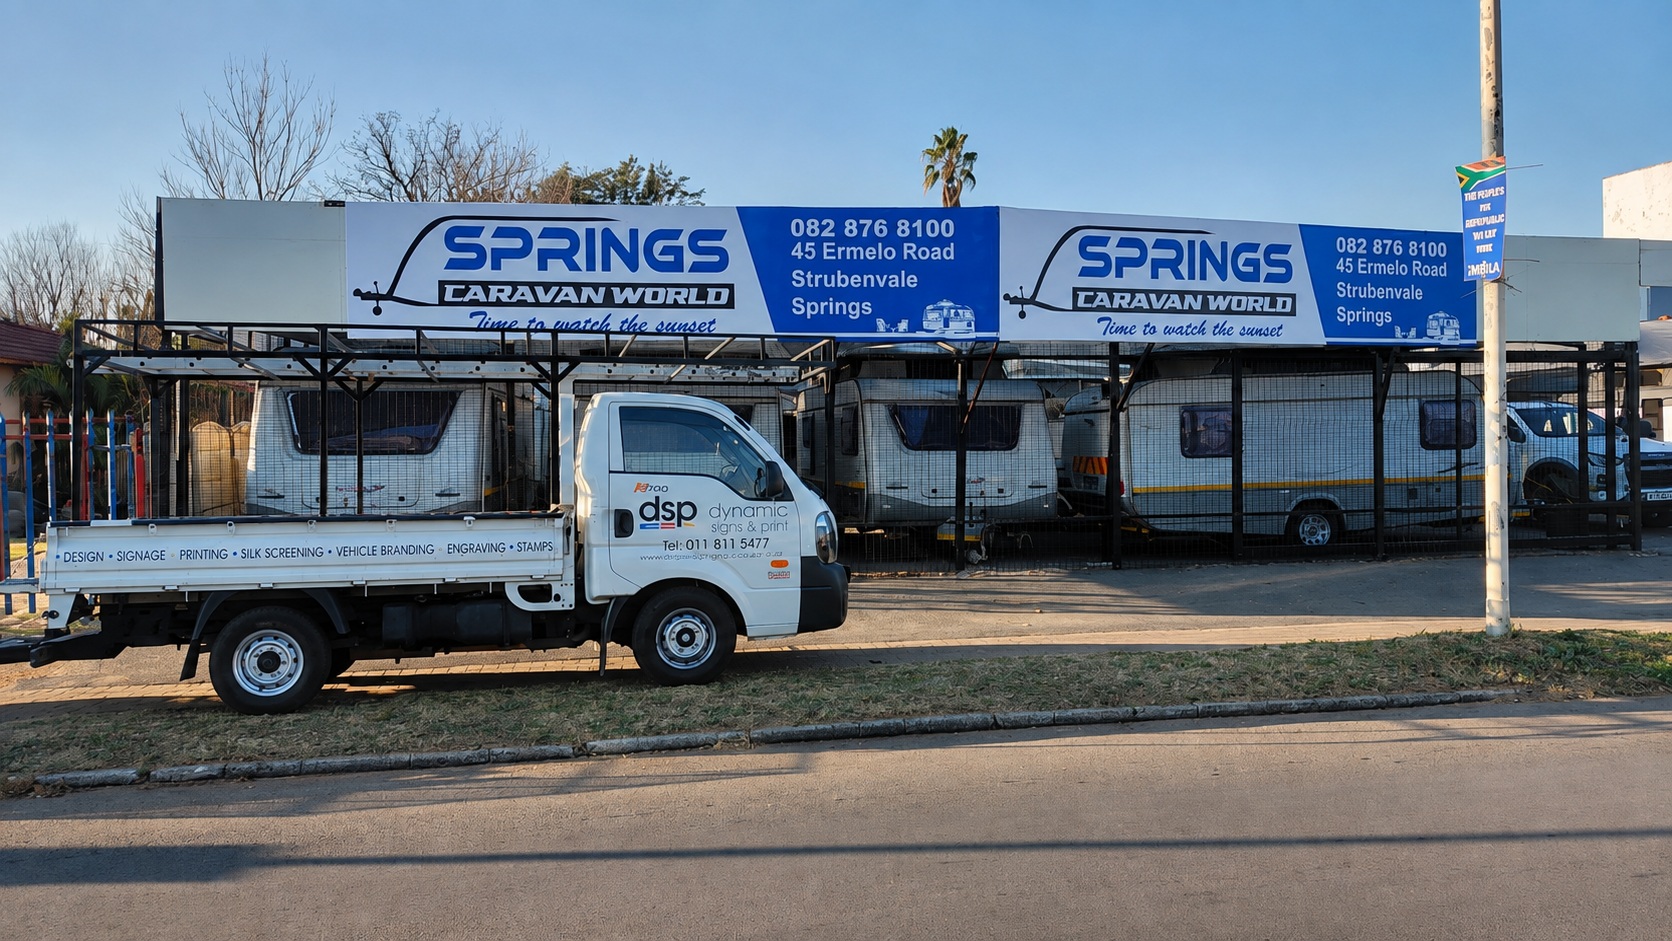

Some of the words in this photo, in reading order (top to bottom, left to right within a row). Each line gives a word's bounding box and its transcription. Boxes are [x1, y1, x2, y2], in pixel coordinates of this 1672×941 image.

[790, 218, 836, 238] 082
[844, 219, 888, 238] 876
[896, 219, 955, 238] 8100
[444, 225, 729, 273] SPRINGS
[791, 242, 816, 260] 45
[823, 242, 896, 260] Ermelo
[903, 242, 955, 260] Road
[1336, 236, 1367, 254] 082
[1373, 238, 1403, 256] 876
[1409, 241, 1447, 257] 8100
[1078, 235, 1293, 283] SPRINGS
[1336, 257, 1353, 274] 45
[1358, 258, 1408, 276] Ermelo
[1412, 260, 1447, 277] Road
[791, 269, 918, 288] Strubenvale
[444, 284, 606, 304] CARAVAN
[611, 287, 730, 305] WORLD
[1336, 281, 1423, 300] Strubenvale
[791, 296, 872, 319] Springs
[1076, 291, 1202, 311] CARAVAN
[1207, 295, 1292, 313] WORLD
[469, 310, 519, 331] Time
[528, 317, 544, 332] to
[554, 312, 612, 332] watch
[619, 313, 648, 333] the
[655, 318, 717, 333] sunset
[1097, 316, 1136, 336] Time
[1143, 322, 1157, 336] to
[1163, 320, 1206, 336] watch
[1212, 320, 1234, 337] the
[1239, 323, 1283, 337] sunset
[1336, 306, 1392, 327] Springs
[639, 495, 698, 527] dsp
[709, 502, 788, 521] dynamic
[711, 521, 743, 536] signs
[748, 521, 757, 532] &
[761, 519, 788, 534] print
[63, 551, 105, 563] DESIGN
[116, 549, 166, 562] SIGNAGE
[179, 548, 229, 561] PRINTING
[240, 548, 262, 560] SILK
[265, 546, 324, 560] SCREENING
[336, 545, 377, 557] VEHICLE
[381, 543, 435, 556] BRANDING
[447, 542, 506, 555] ENGRAVING
[516, 541, 554, 553] STAMPS
[663, 540, 682, 551] Tel:
[686, 539, 707, 550] 011
[714, 538, 735, 550] 811
[740, 537, 770, 549] 5477
